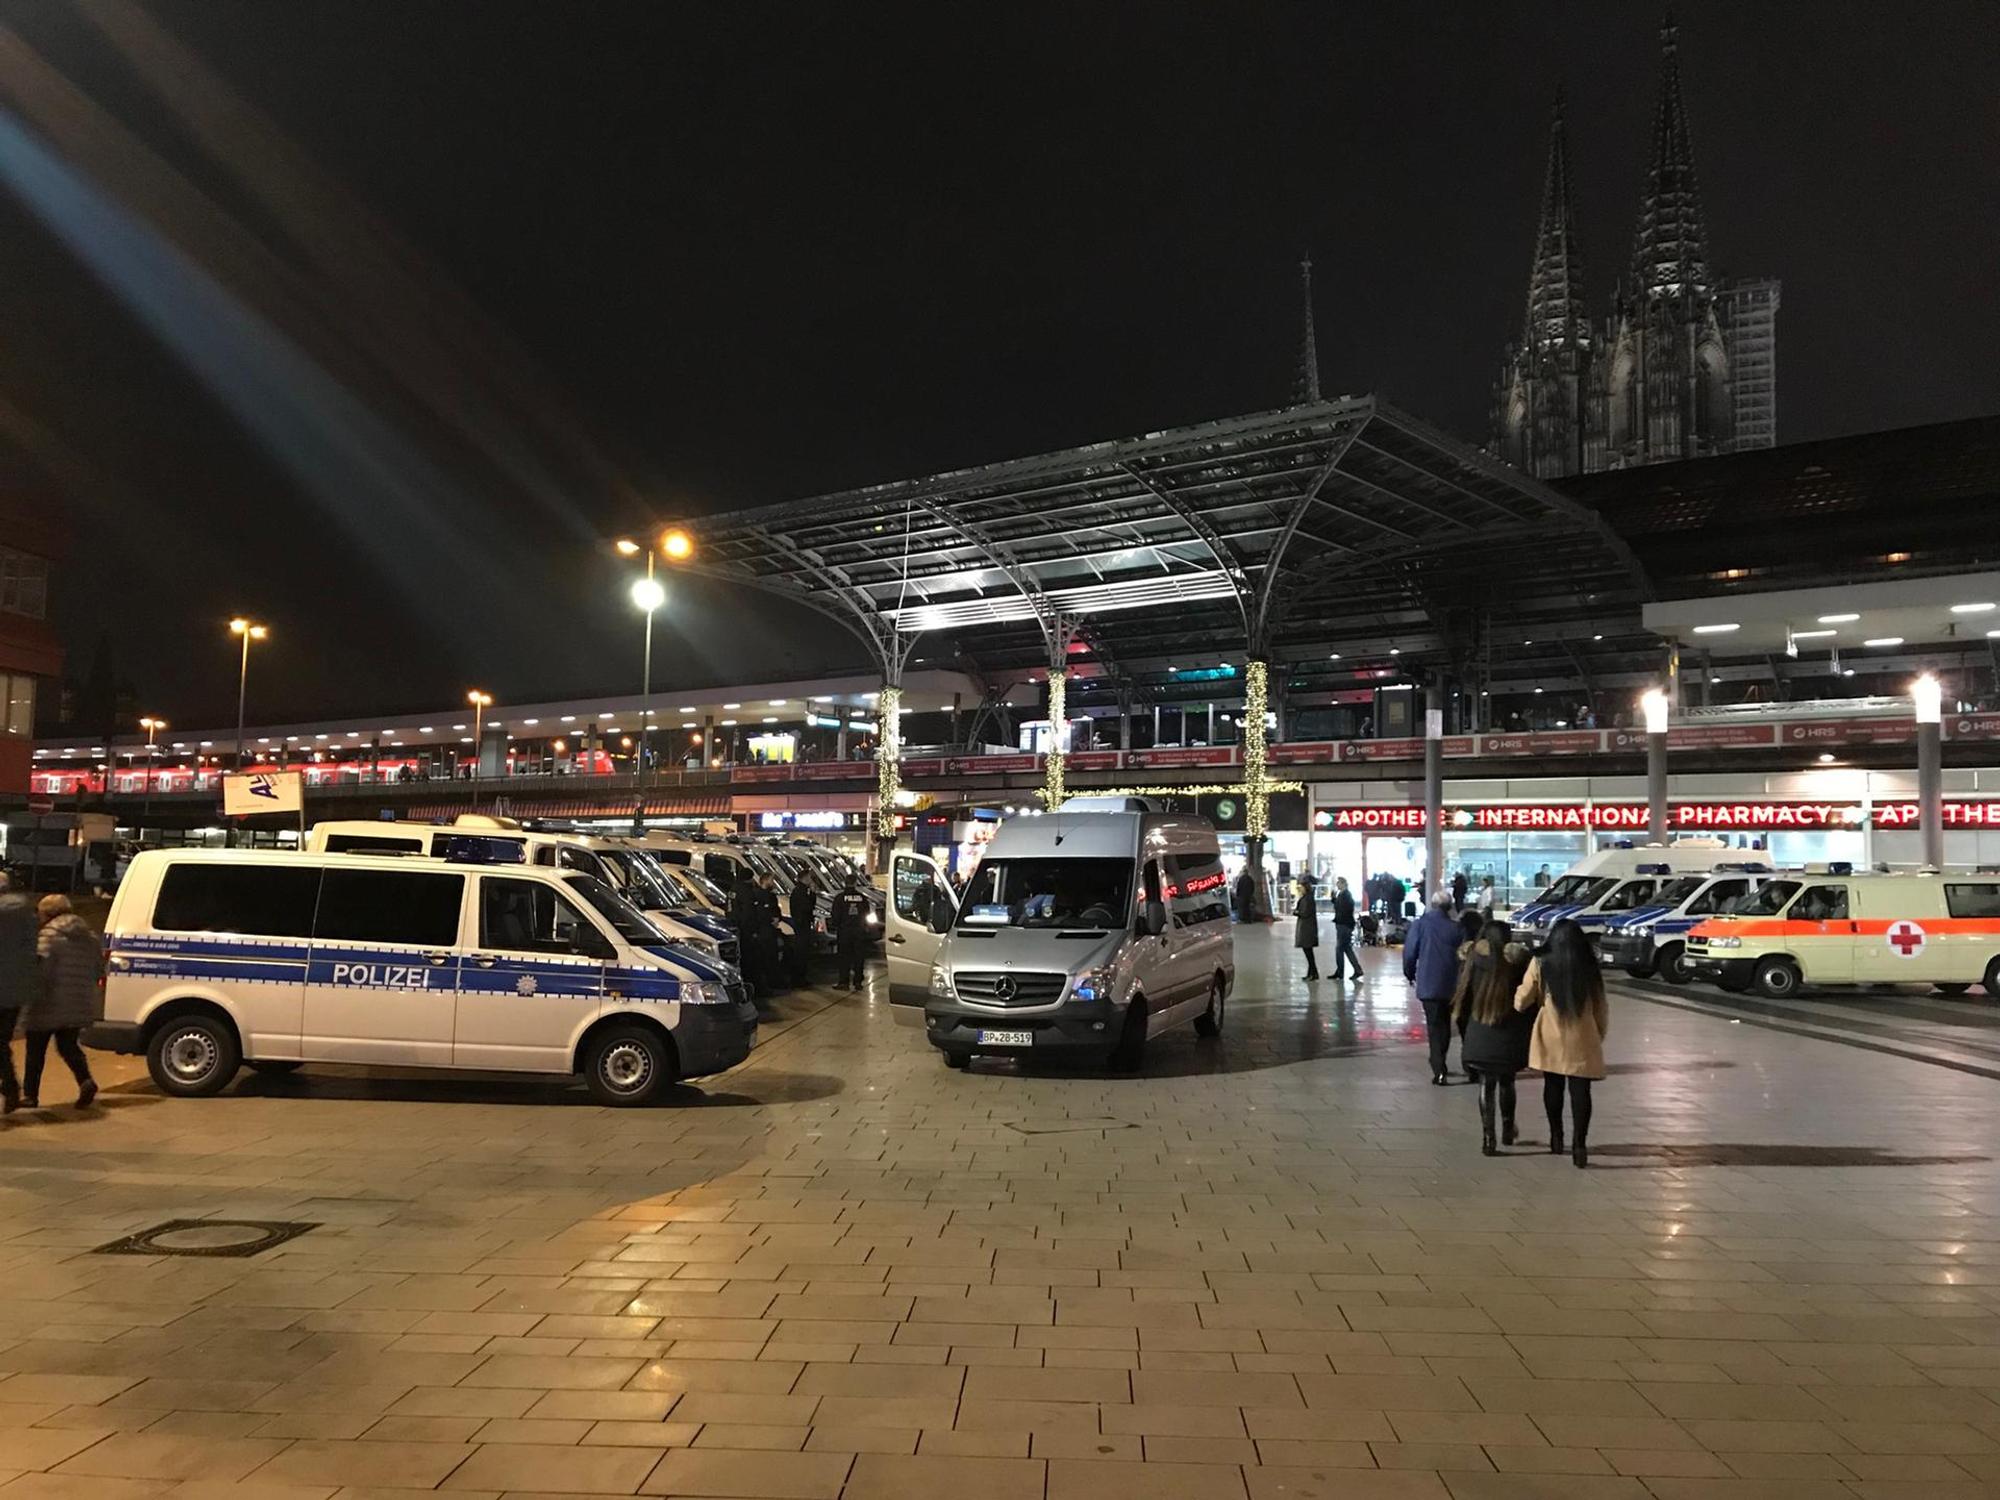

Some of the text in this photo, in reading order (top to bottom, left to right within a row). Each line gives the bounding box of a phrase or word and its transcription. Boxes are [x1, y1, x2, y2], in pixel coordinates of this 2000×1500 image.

[1808, 727, 1837, 737] HRS
[1500, 740, 1523, 748] HRS
[1218, 801, 1235, 819] S
[1479, 807, 1672, 826] INTERNATIONA
[1679, 804, 1832, 825] PHARMACY
[1880, 802, 2000, 824] APTHE
[332, 963, 431, 988] POLIZEI
[983, 1032, 995, 1042] BP
